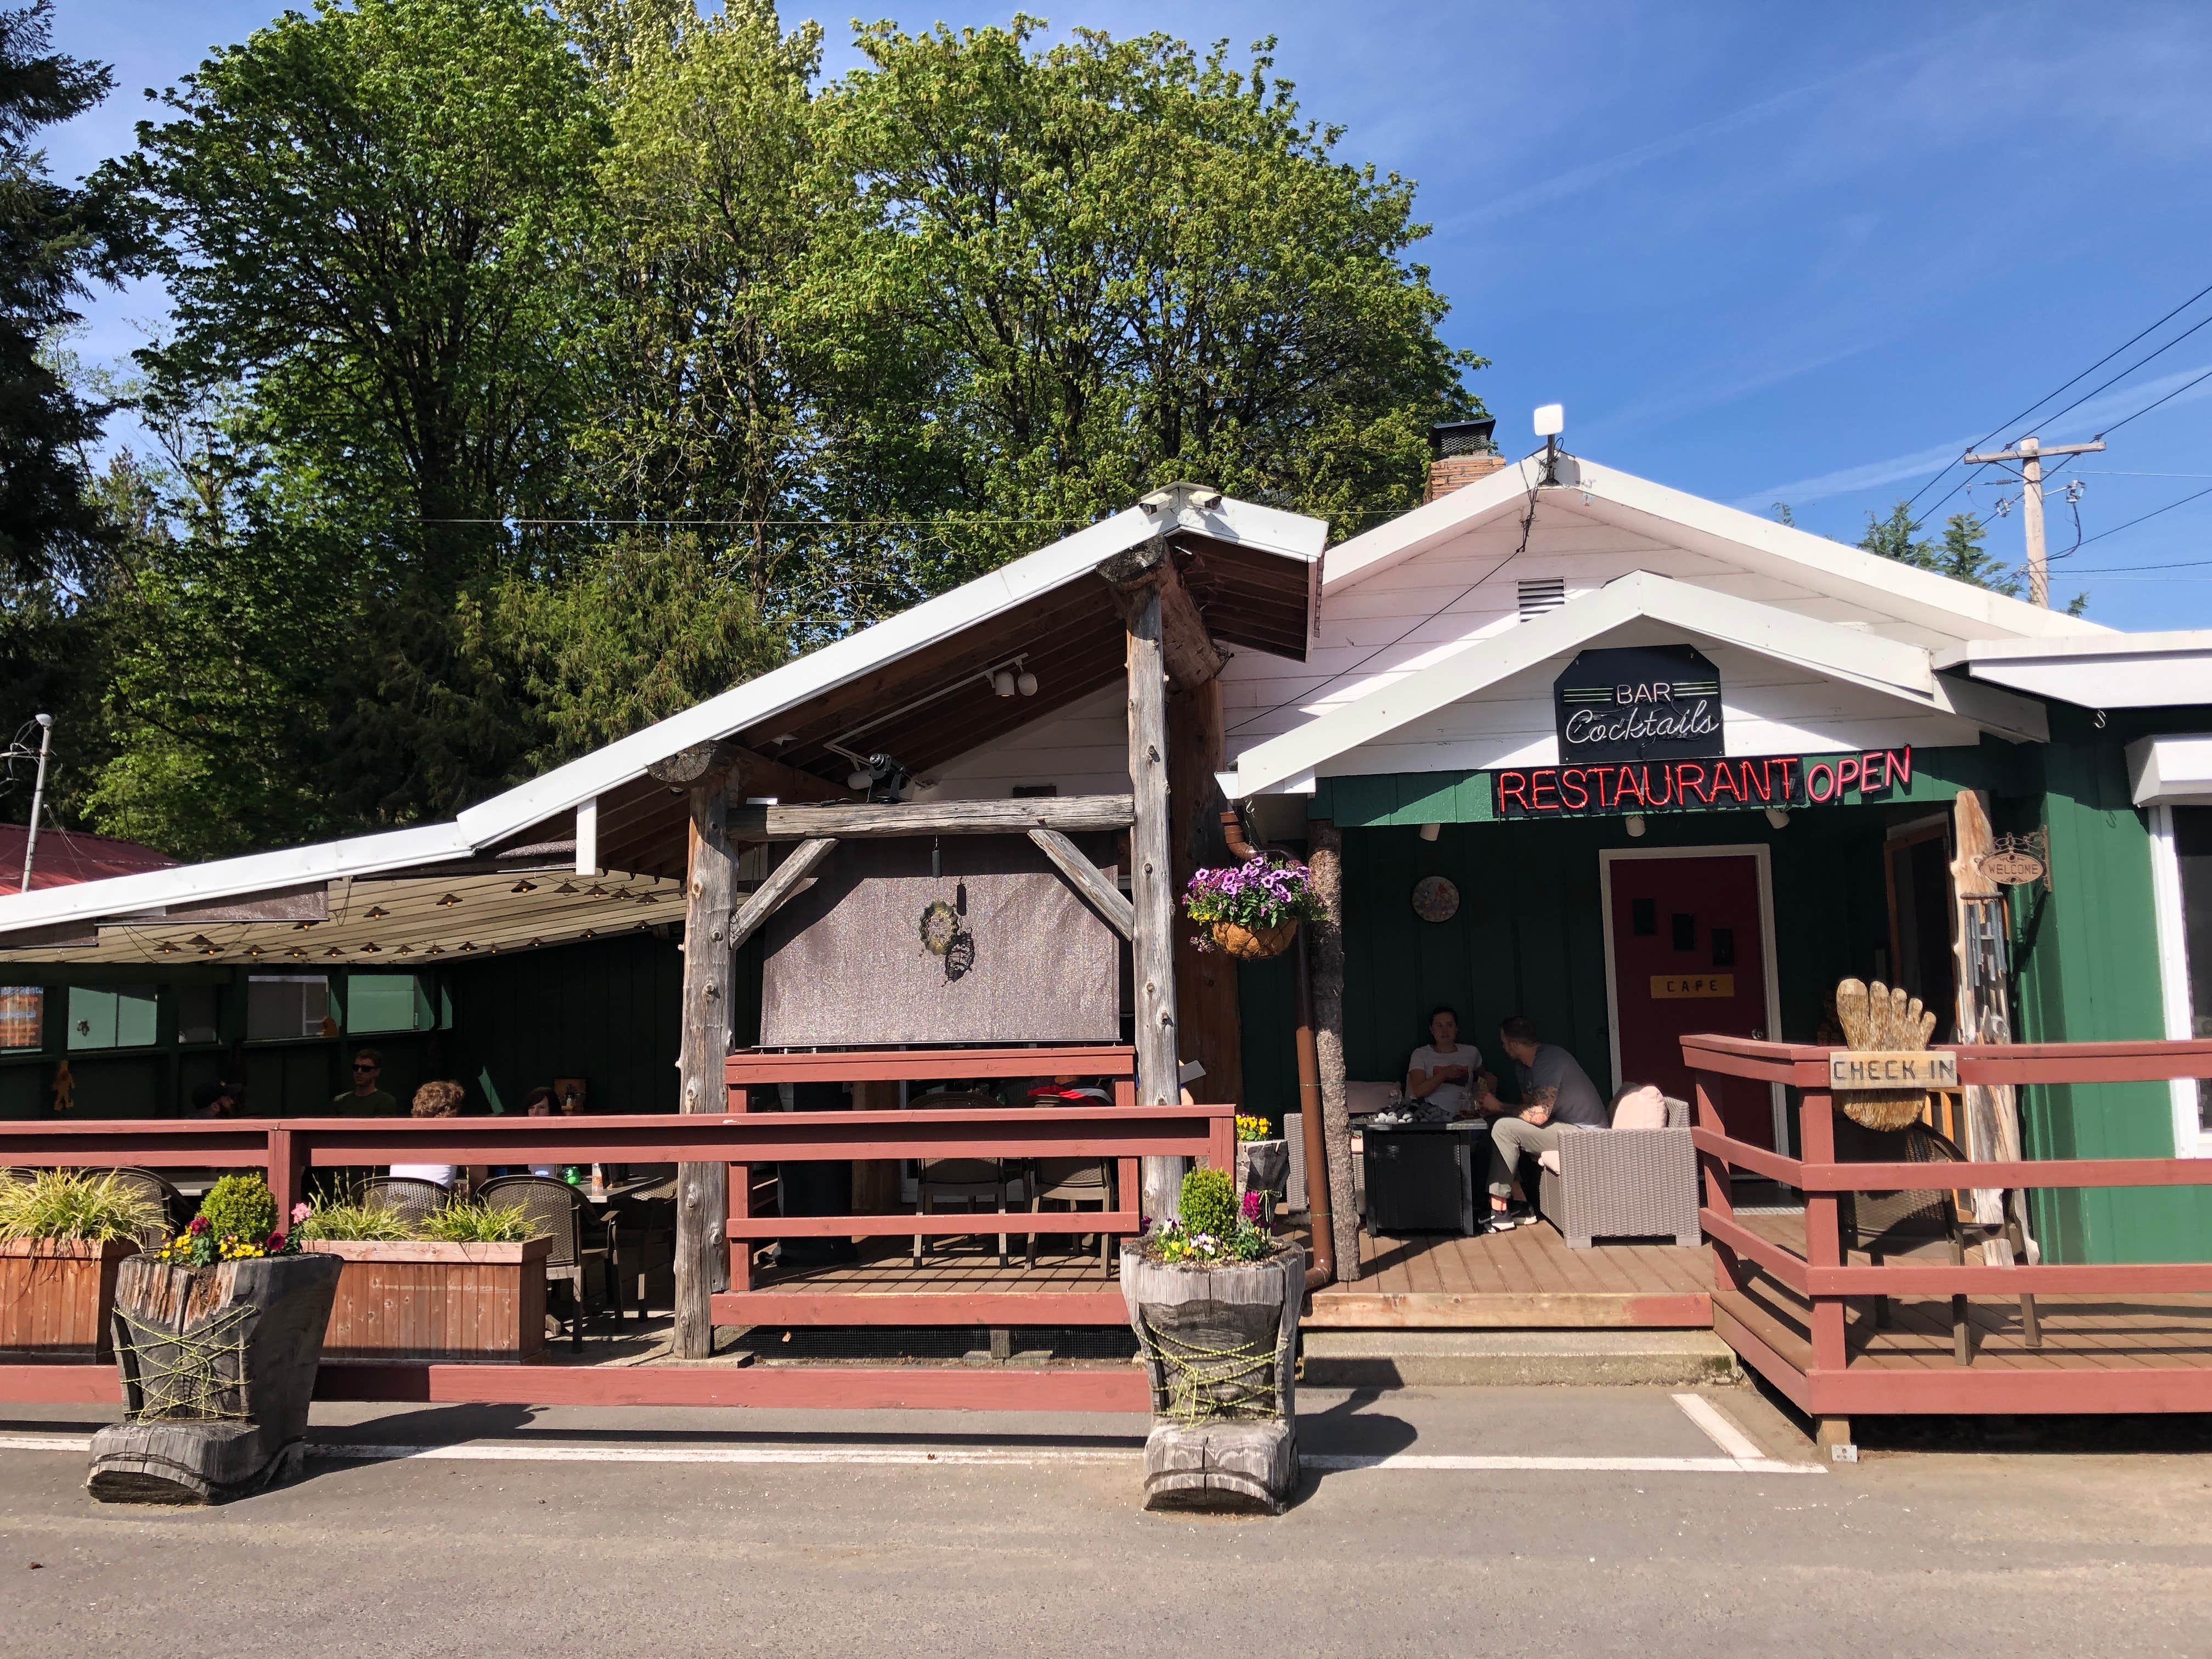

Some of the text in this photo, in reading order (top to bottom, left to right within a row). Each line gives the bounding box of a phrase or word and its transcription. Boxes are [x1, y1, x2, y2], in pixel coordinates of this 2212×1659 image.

[1617, 682, 1671, 704] BAR
[1566, 699, 1719, 743] Cocktails
[1499, 744, 1911, 812] RESTAURANT OPEN
[1988, 864, 2038, 874] WELCOME
[1667, 980, 1718, 992] CAFE
[1833, 1059, 1955, 1081] CHECK IN
